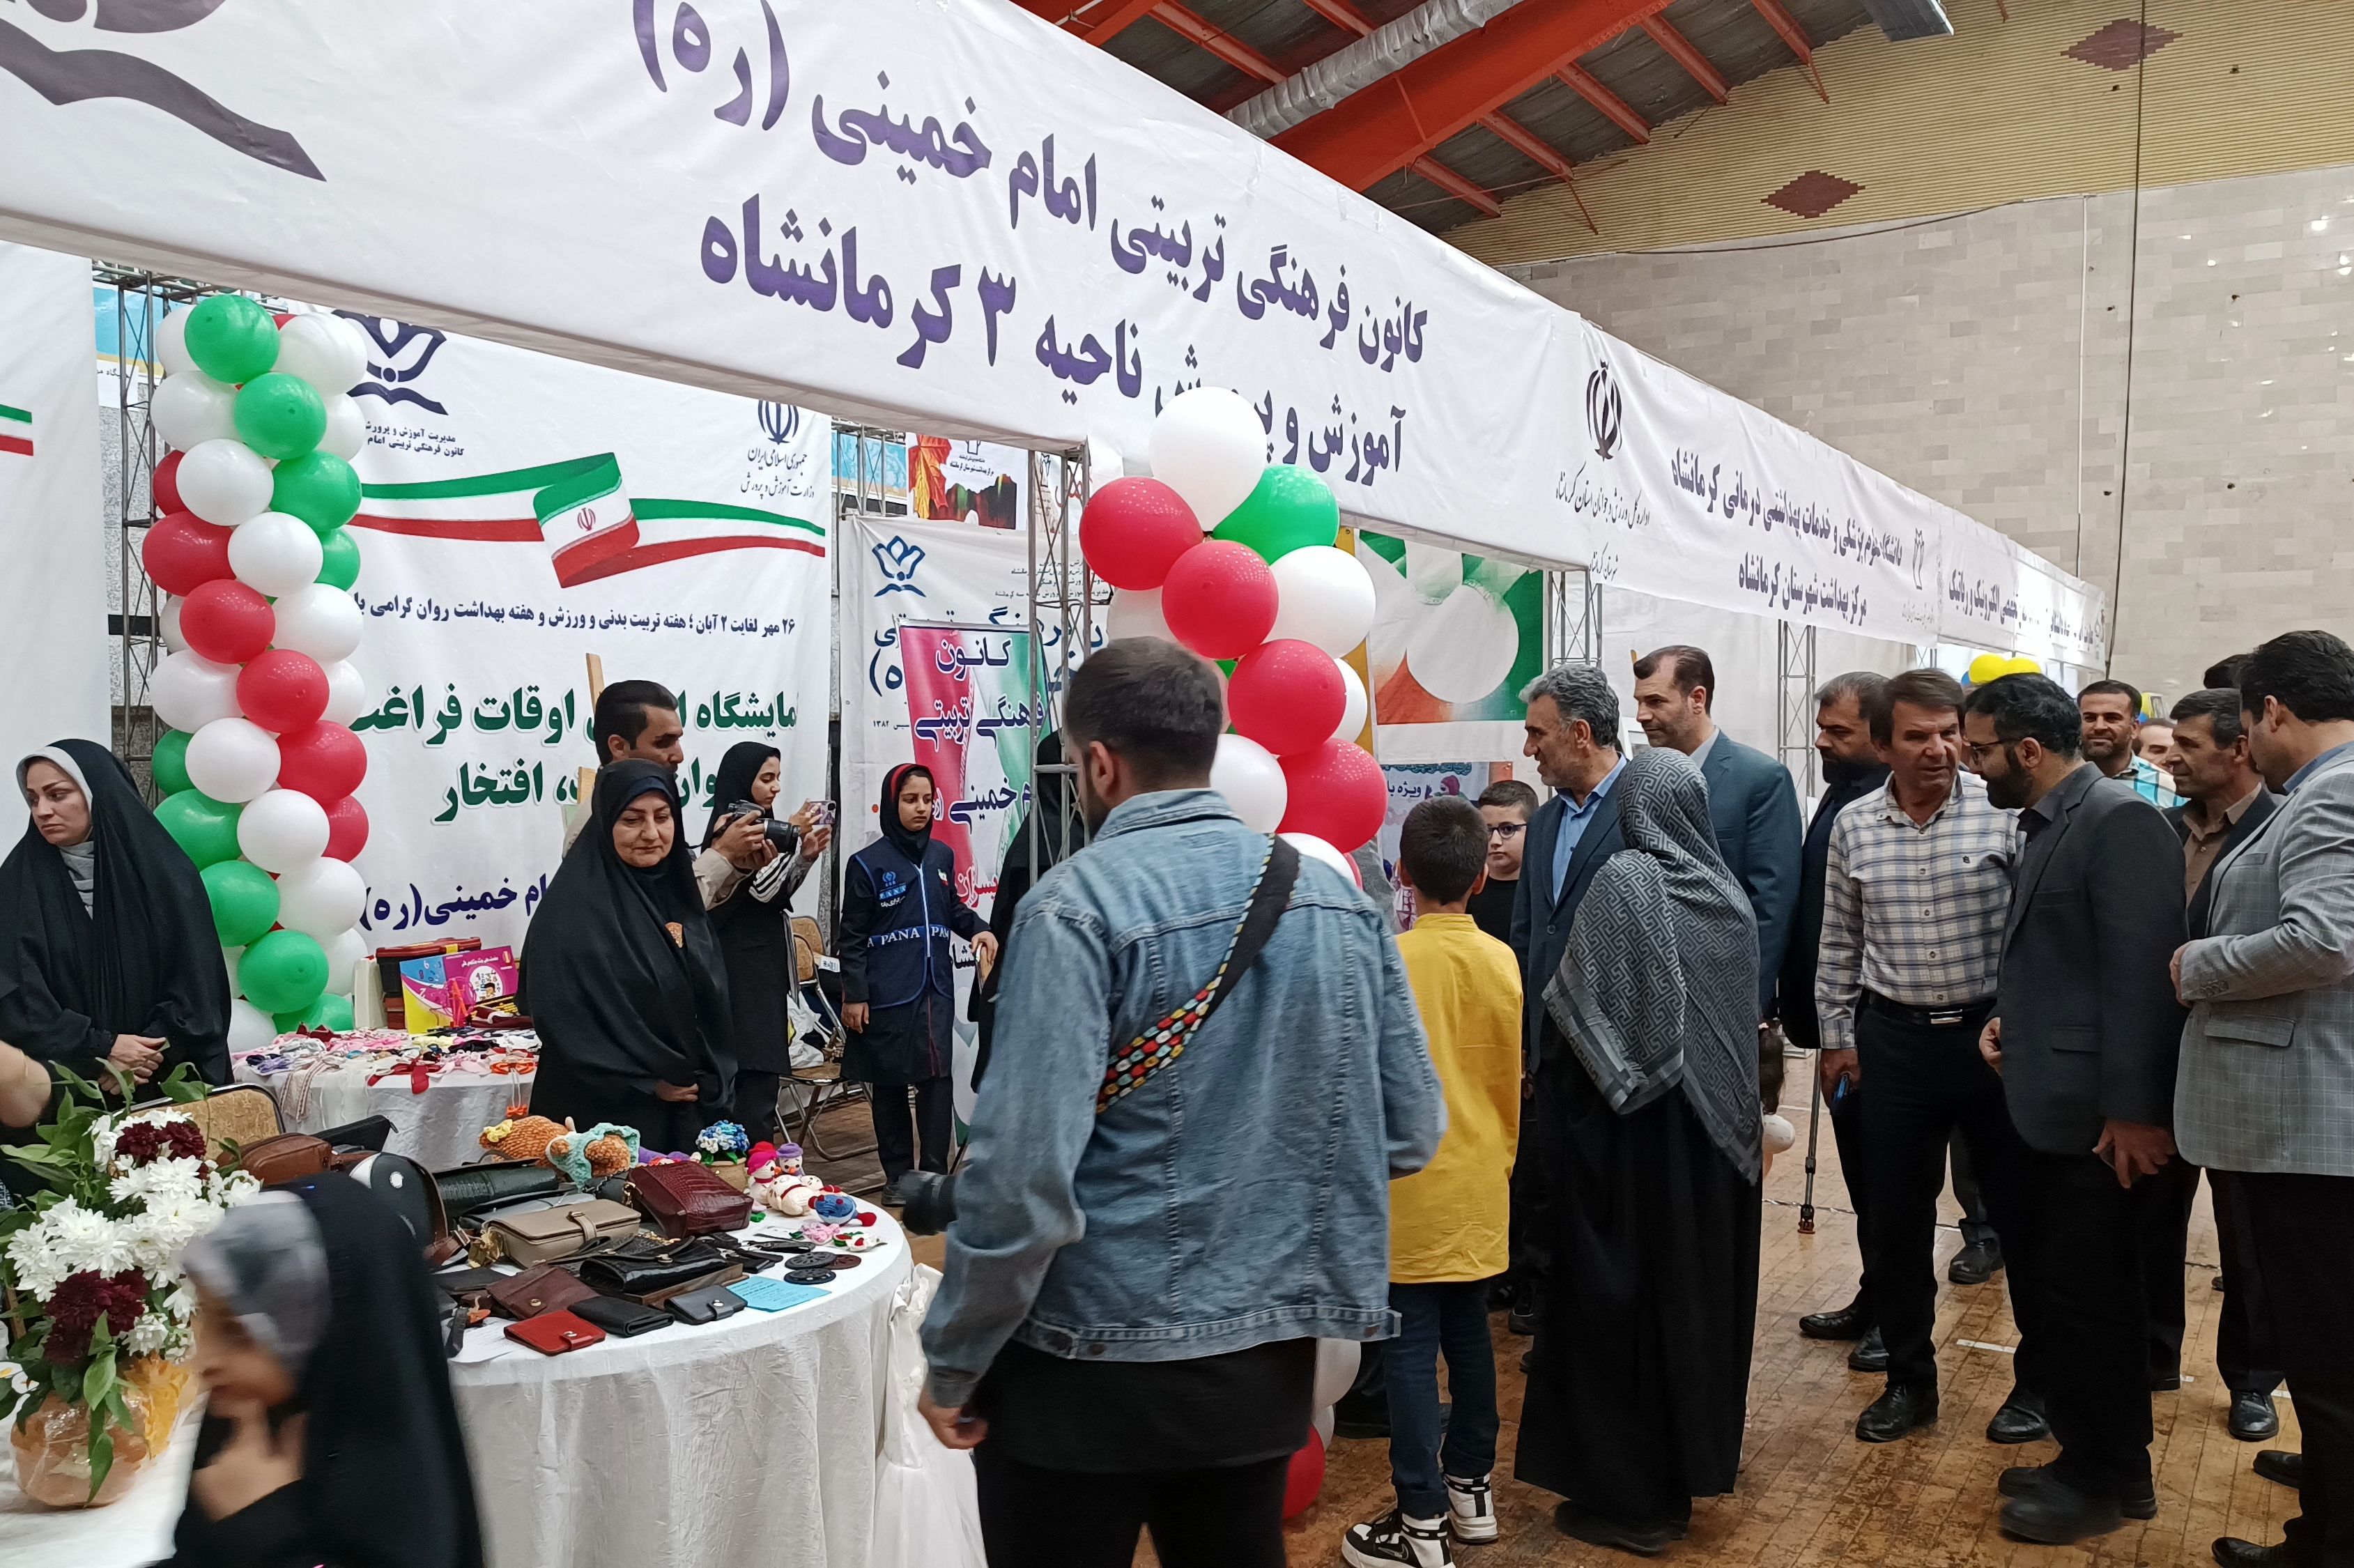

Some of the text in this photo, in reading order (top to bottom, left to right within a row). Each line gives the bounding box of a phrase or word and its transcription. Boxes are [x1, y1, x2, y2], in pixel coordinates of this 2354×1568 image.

[633, 0, 1427, 372] کانون فرهنگی تربیتی امام خمینی (ره)
[700, 193, 960, 368] کرمانشاه
[979, 266, 1016, 367] ۳
[1035, 316, 1142, 404] ناحیه
[367, 435, 464, 457] کانون فرهنگی تربیتی امام
[399, 426, 425, 440] آموزش
[428, 432, 456, 443] مدیریت
[1282, 406, 1299, 465] و
[1308, 392, 1406, 486] آموزش
[748, 447, 808, 476] جمهوری اسلامی ایران
[741, 472, 764, 500] پرورش
[769, 475, 792, 497] آموزش
[1671, 446, 1721, 513] کرمانشاه
[1723, 470, 1761, 527] درمانی
[1763, 489, 1801, 540] بهداشتی
[1802, 501, 1831, 539] خدمات
[1839, 517, 1864, 564] پزشکی
[1739, 551, 1780, 608] کرمانشاه
[1782, 564, 1819, 615] شهرستان
[353, 592, 366, 615] با
[370, 594, 413, 619] گرامی
[416, 598, 449, 622] روان
[454, 601, 505, 623] بهداشت
[508, 604, 534, 620] هفته
[1820, 577, 1849, 621] بهداشت
[1849, 584, 1868, 627] مرکز
[537, 612, 545, 627] و
[548, 606, 586, 629] ورزش
[589, 614, 596, 629] و
[599, 609, 627, 629] بدنی
[629, 613, 661, 632] تربیت
[663, 613, 686, 629] هفته
[695, 613, 719, 634] آبان
[721, 615, 727, 632] ۲
[730, 617, 757, 636] لغایت
[762, 620, 780, 638] مهر
[783, 617, 795, 635] ۲۶
[937, 638, 1011, 679] کانون
[348, 683, 463, 745] فراغ
[474, 685, 576, 744] اوقات
[696, 690, 799, 738] مایشگاه
[916, 699, 971, 750] تربیتی
[434, 758, 544, 822] افتخار
[1397, 781, 1422, 798] ویژه
[949, 776, 1017, 835] خمینی
[880, 927, 921, 946] PANA
